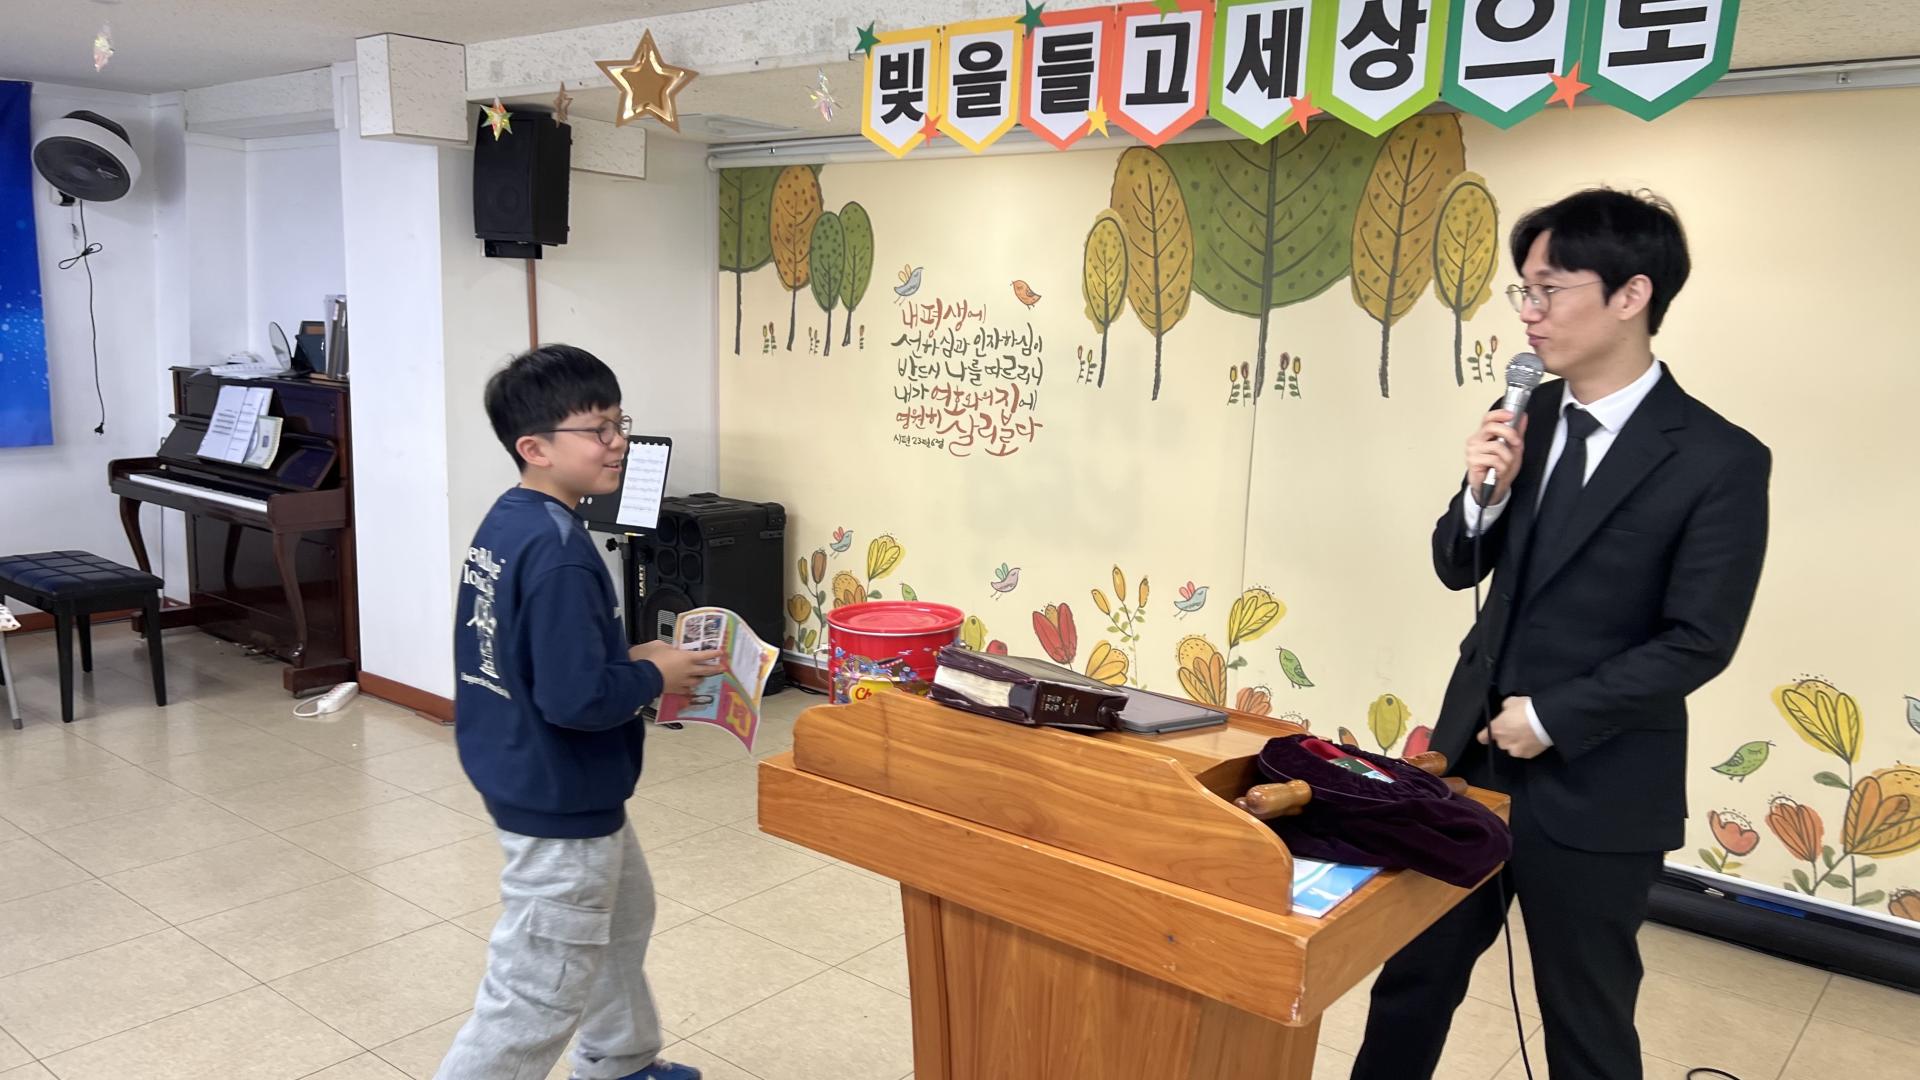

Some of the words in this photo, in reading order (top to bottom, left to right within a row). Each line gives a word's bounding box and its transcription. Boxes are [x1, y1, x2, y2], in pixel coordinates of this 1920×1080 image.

[879, 41, 1008, 125] 빛을
[1037, 22, 1192, 115] 들고
[890, 327, 970, 358] 선하심과
[973, 321, 1043, 358] 인자하심이
[897, 355, 941, 382] 반드시
[944, 358, 983, 387] 나를
[984, 354, 1044, 386] 따르리니
[894, 383, 930, 404] 내가
[930, 381, 994, 417] 여호와의
[994, 382, 1038, 426] 집에
[895, 404, 943, 430] 영원히
[935, 412, 1044, 458] 살리로다
